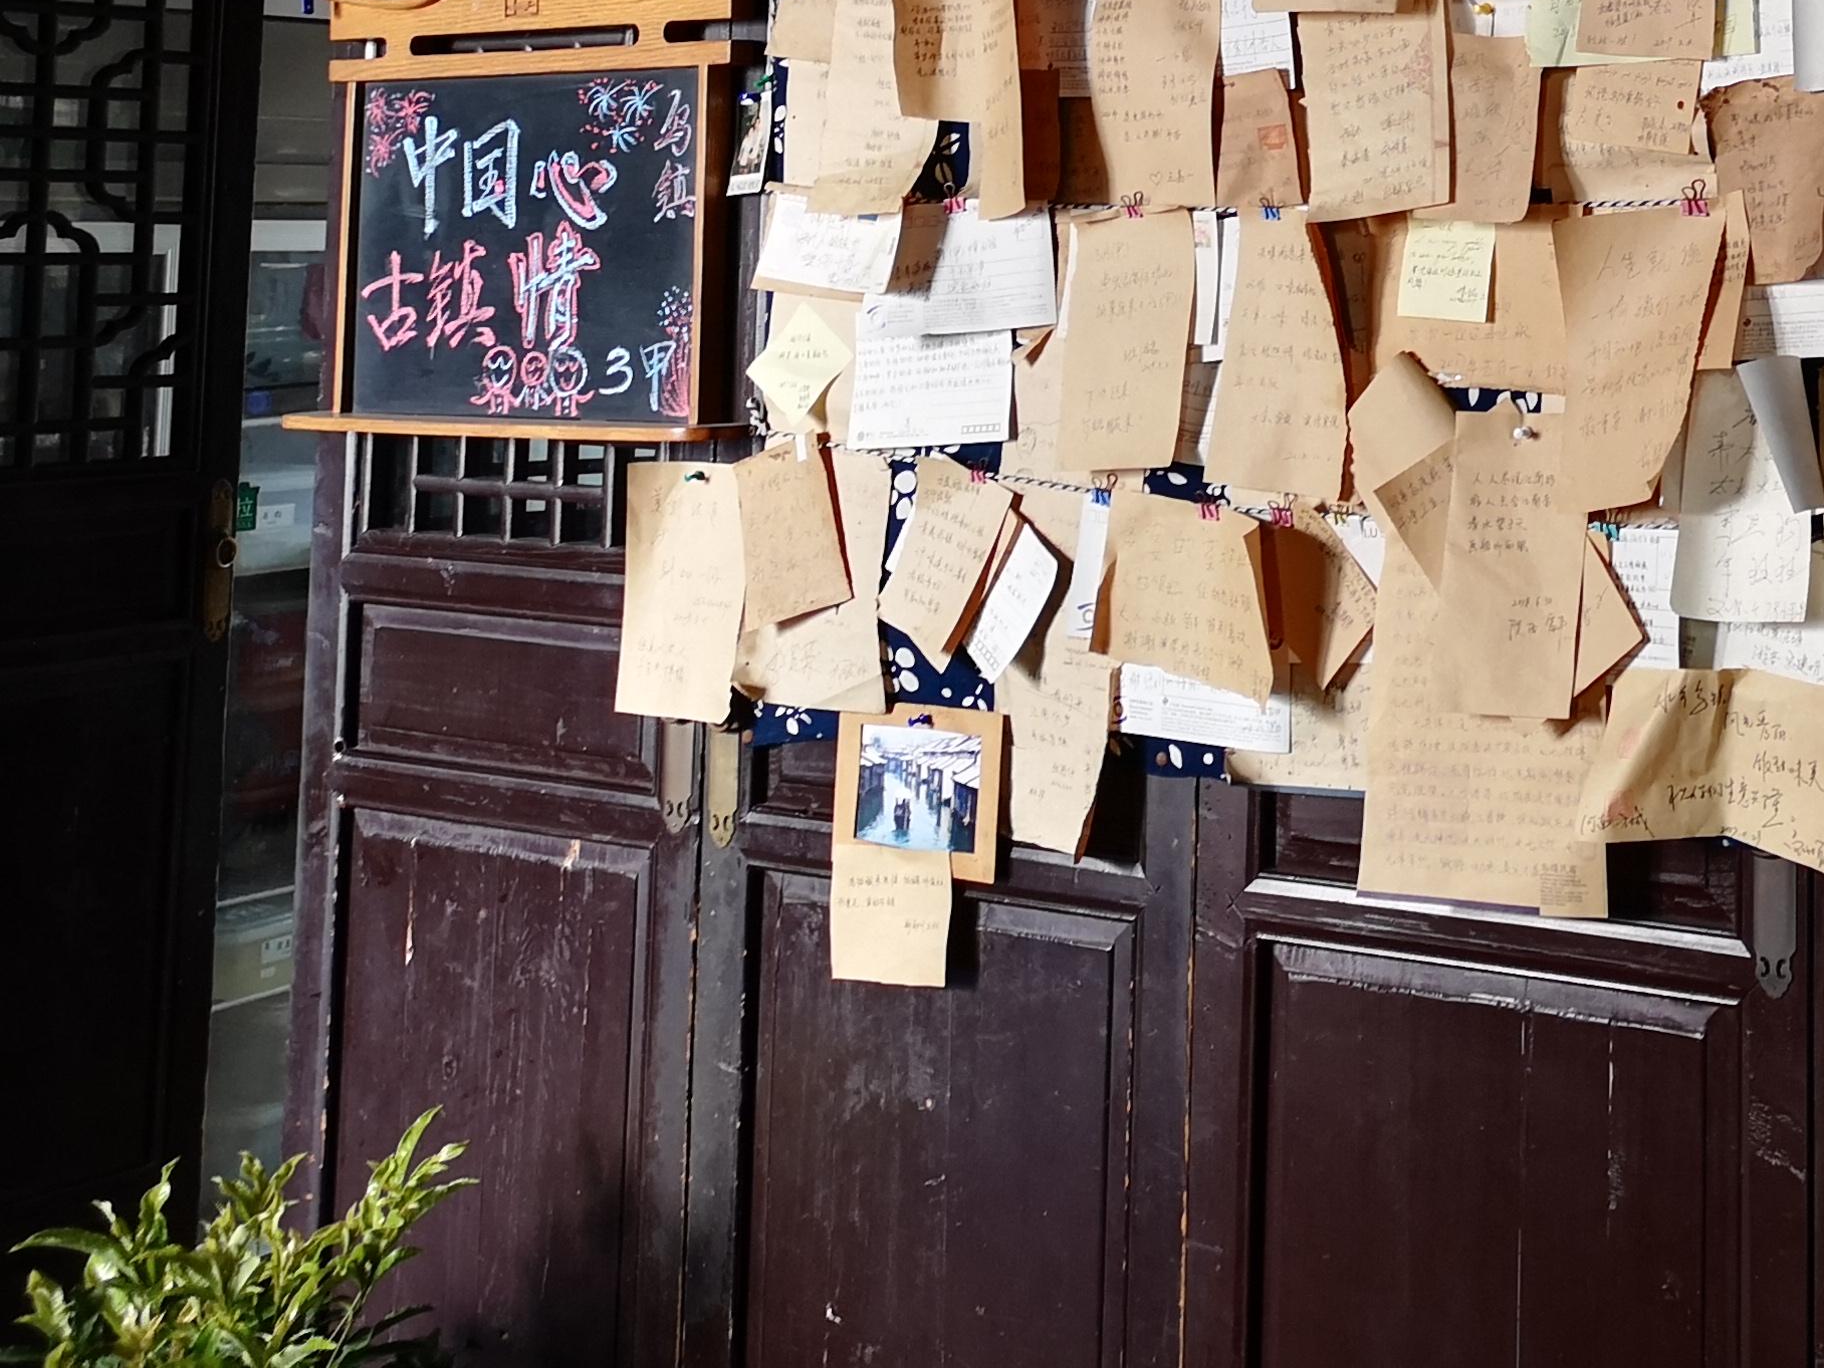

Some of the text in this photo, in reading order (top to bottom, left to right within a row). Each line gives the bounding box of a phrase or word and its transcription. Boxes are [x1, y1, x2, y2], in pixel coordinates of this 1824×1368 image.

[403, 115, 618, 240] 中国心
[361, 220, 602, 352] 古镇情
